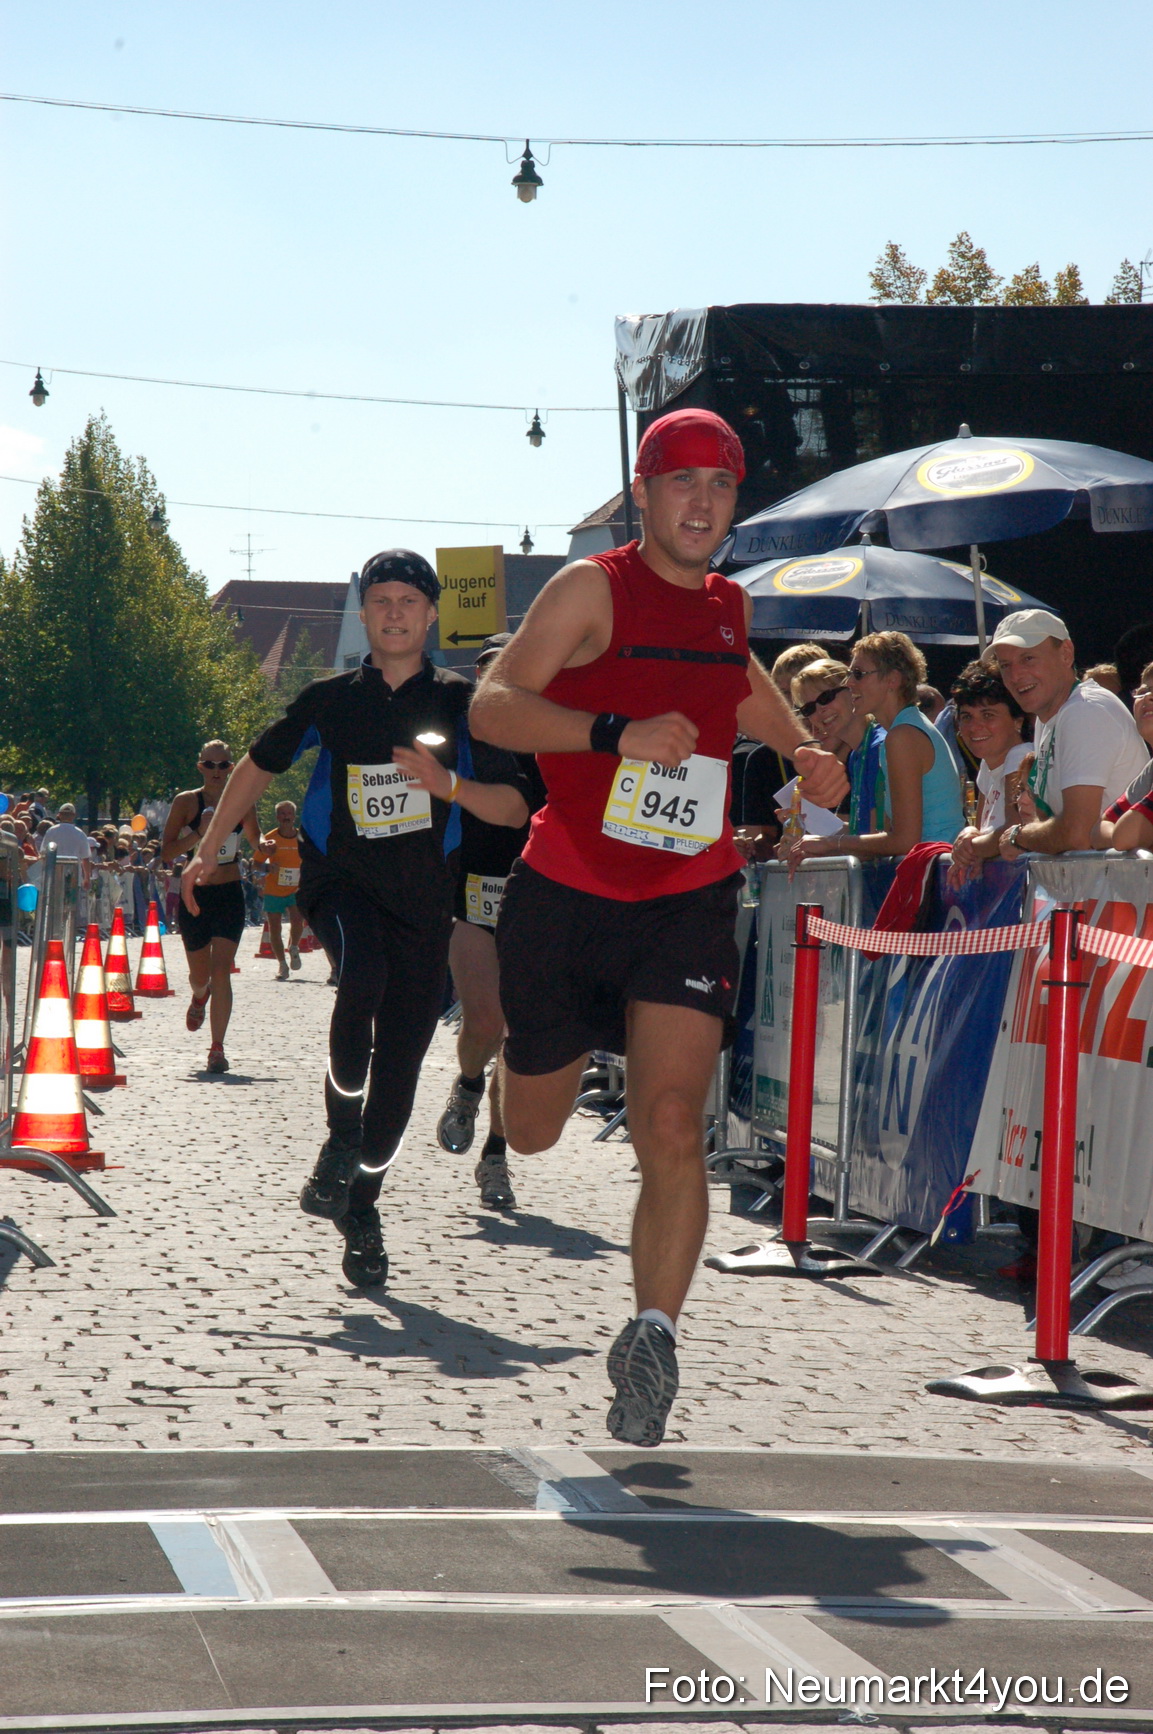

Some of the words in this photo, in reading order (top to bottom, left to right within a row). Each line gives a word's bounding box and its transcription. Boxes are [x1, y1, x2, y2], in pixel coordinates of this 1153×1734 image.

[1097, 506, 1144, 524] DUNKLE
[747, 534, 806, 554] DUNKLE
[441, 573, 496, 593] Jugend
[458, 592, 487, 609] lauf
[620, 777, 634, 793] C
[351, 792, 359, 805] C
[366, 792, 409, 818] 697
[641, 791, 699, 827] 945
[470, 894, 477, 903] C
